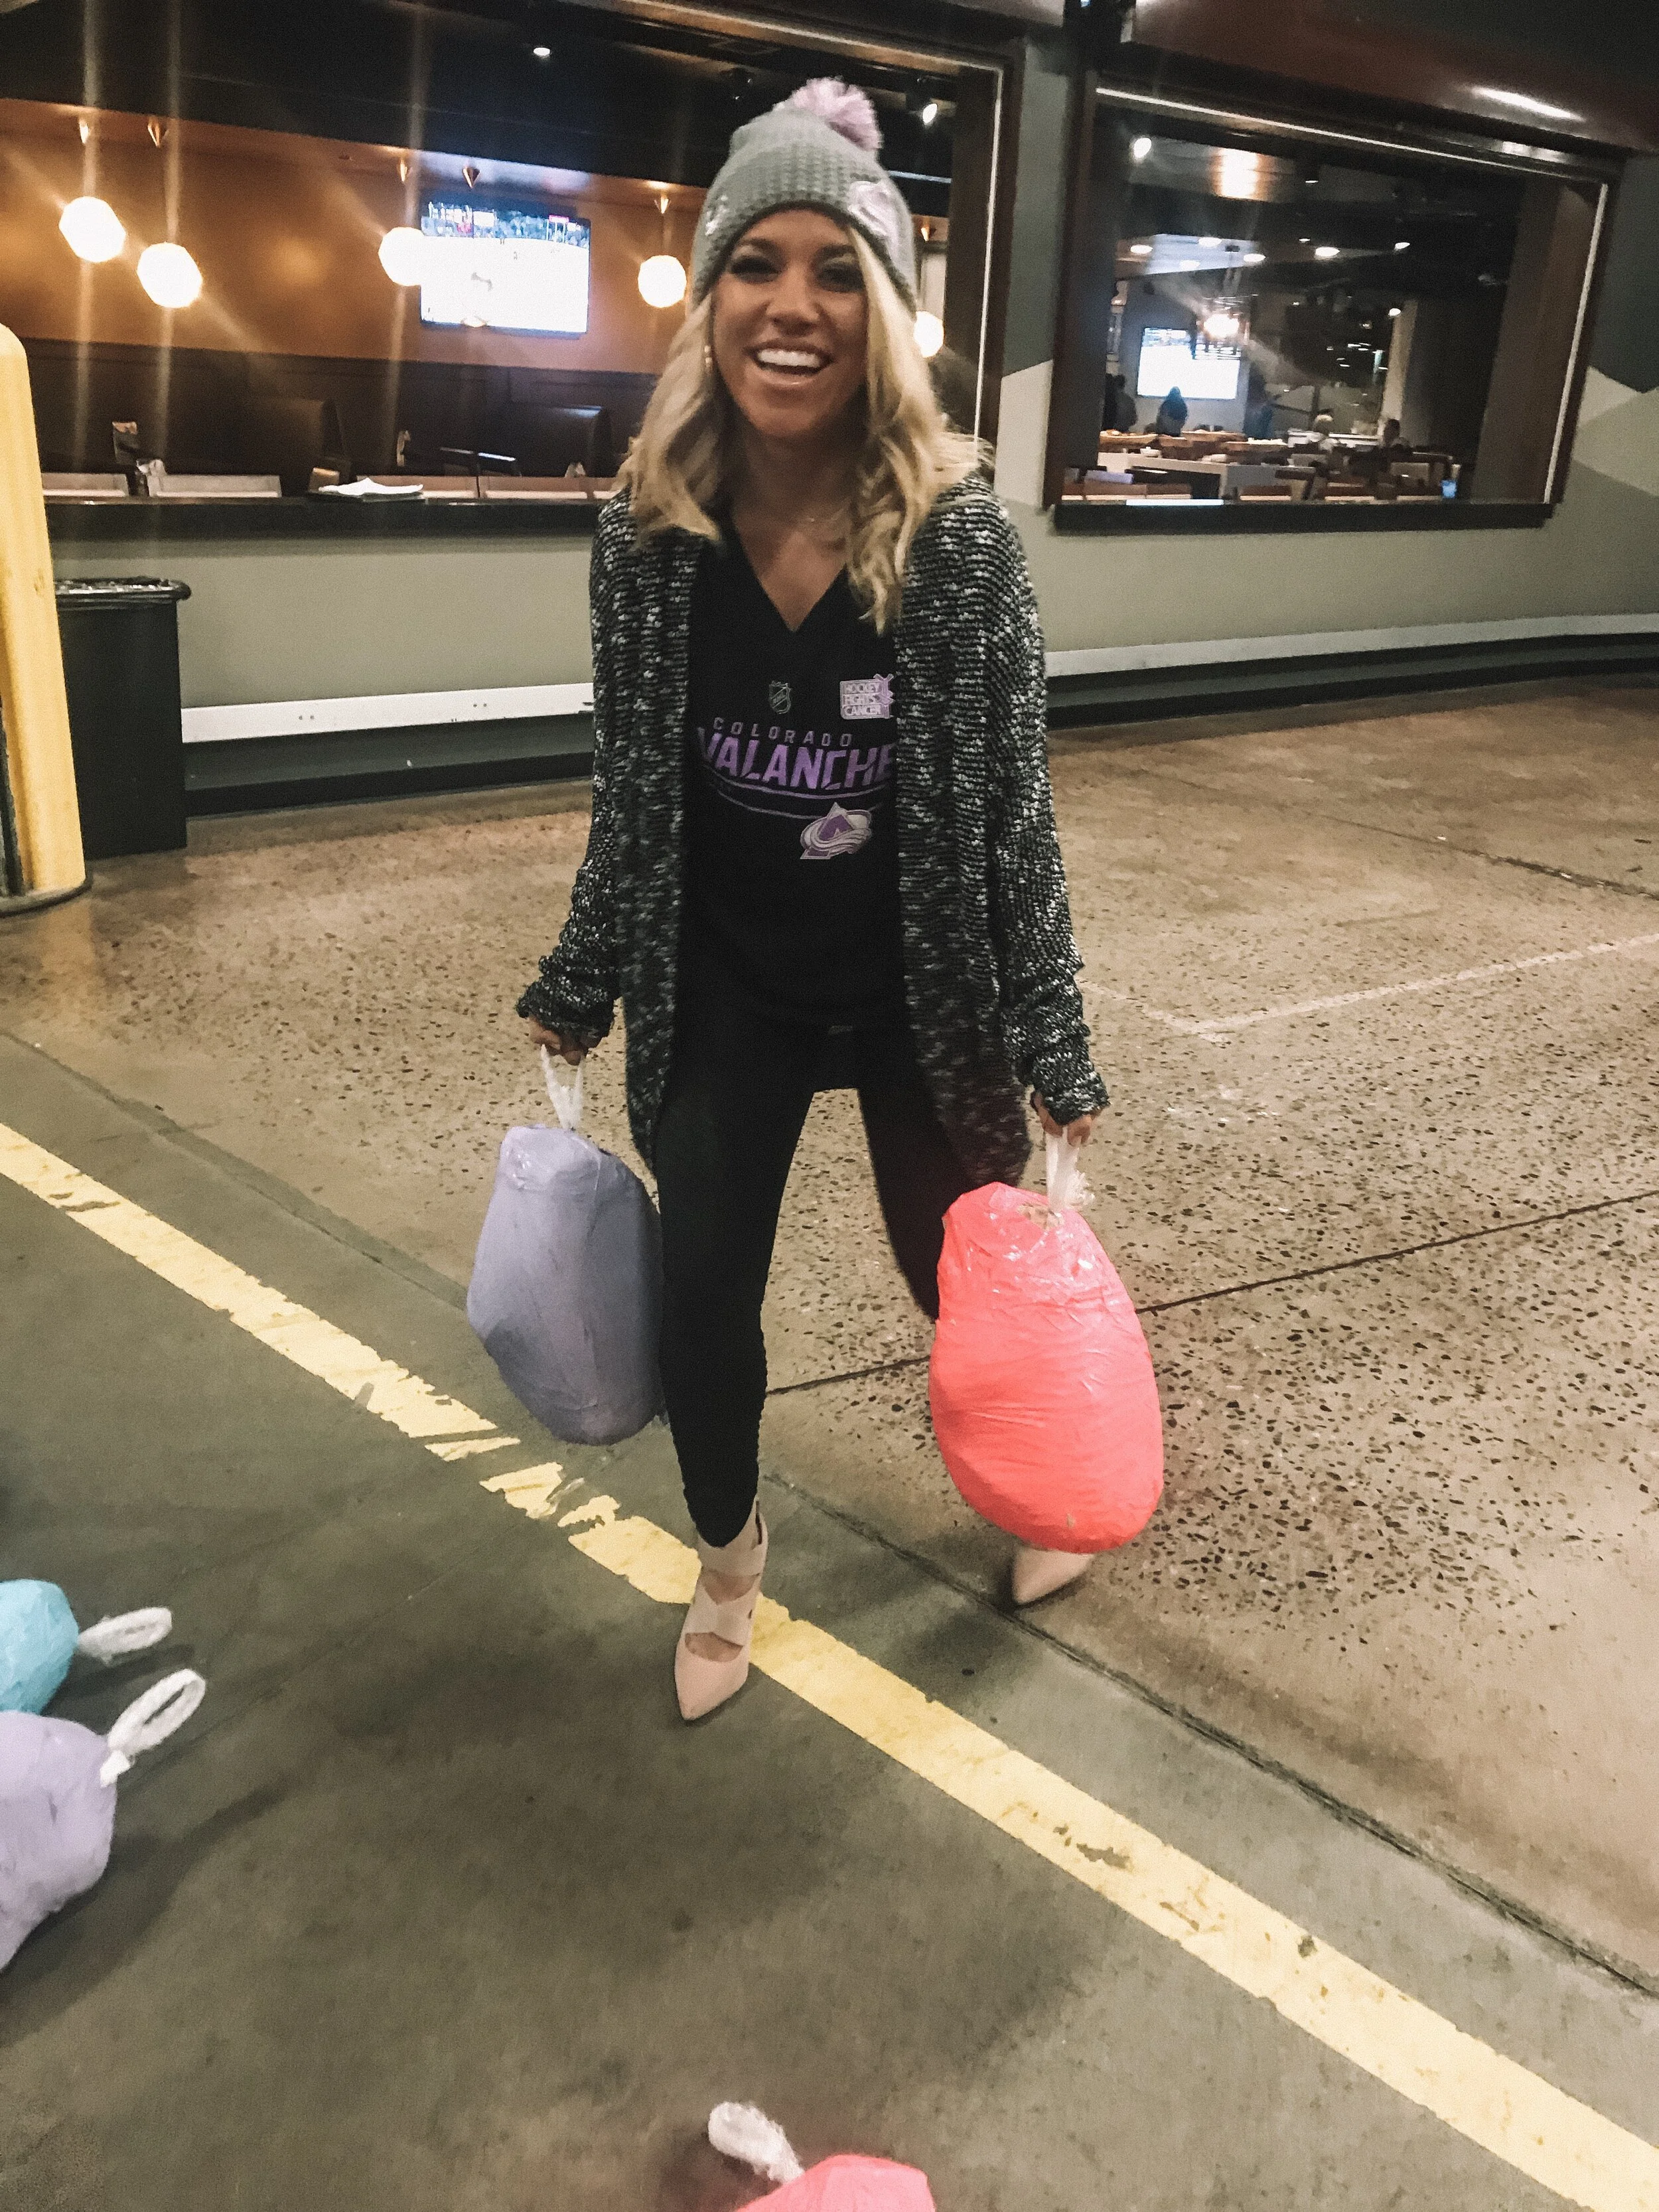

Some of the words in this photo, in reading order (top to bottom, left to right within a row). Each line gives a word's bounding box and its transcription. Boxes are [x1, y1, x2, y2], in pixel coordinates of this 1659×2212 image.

[844, 705, 881, 716] CANCER
[713, 717, 852, 747] COLORADO
[697, 726, 895, 790] VALANCHE
